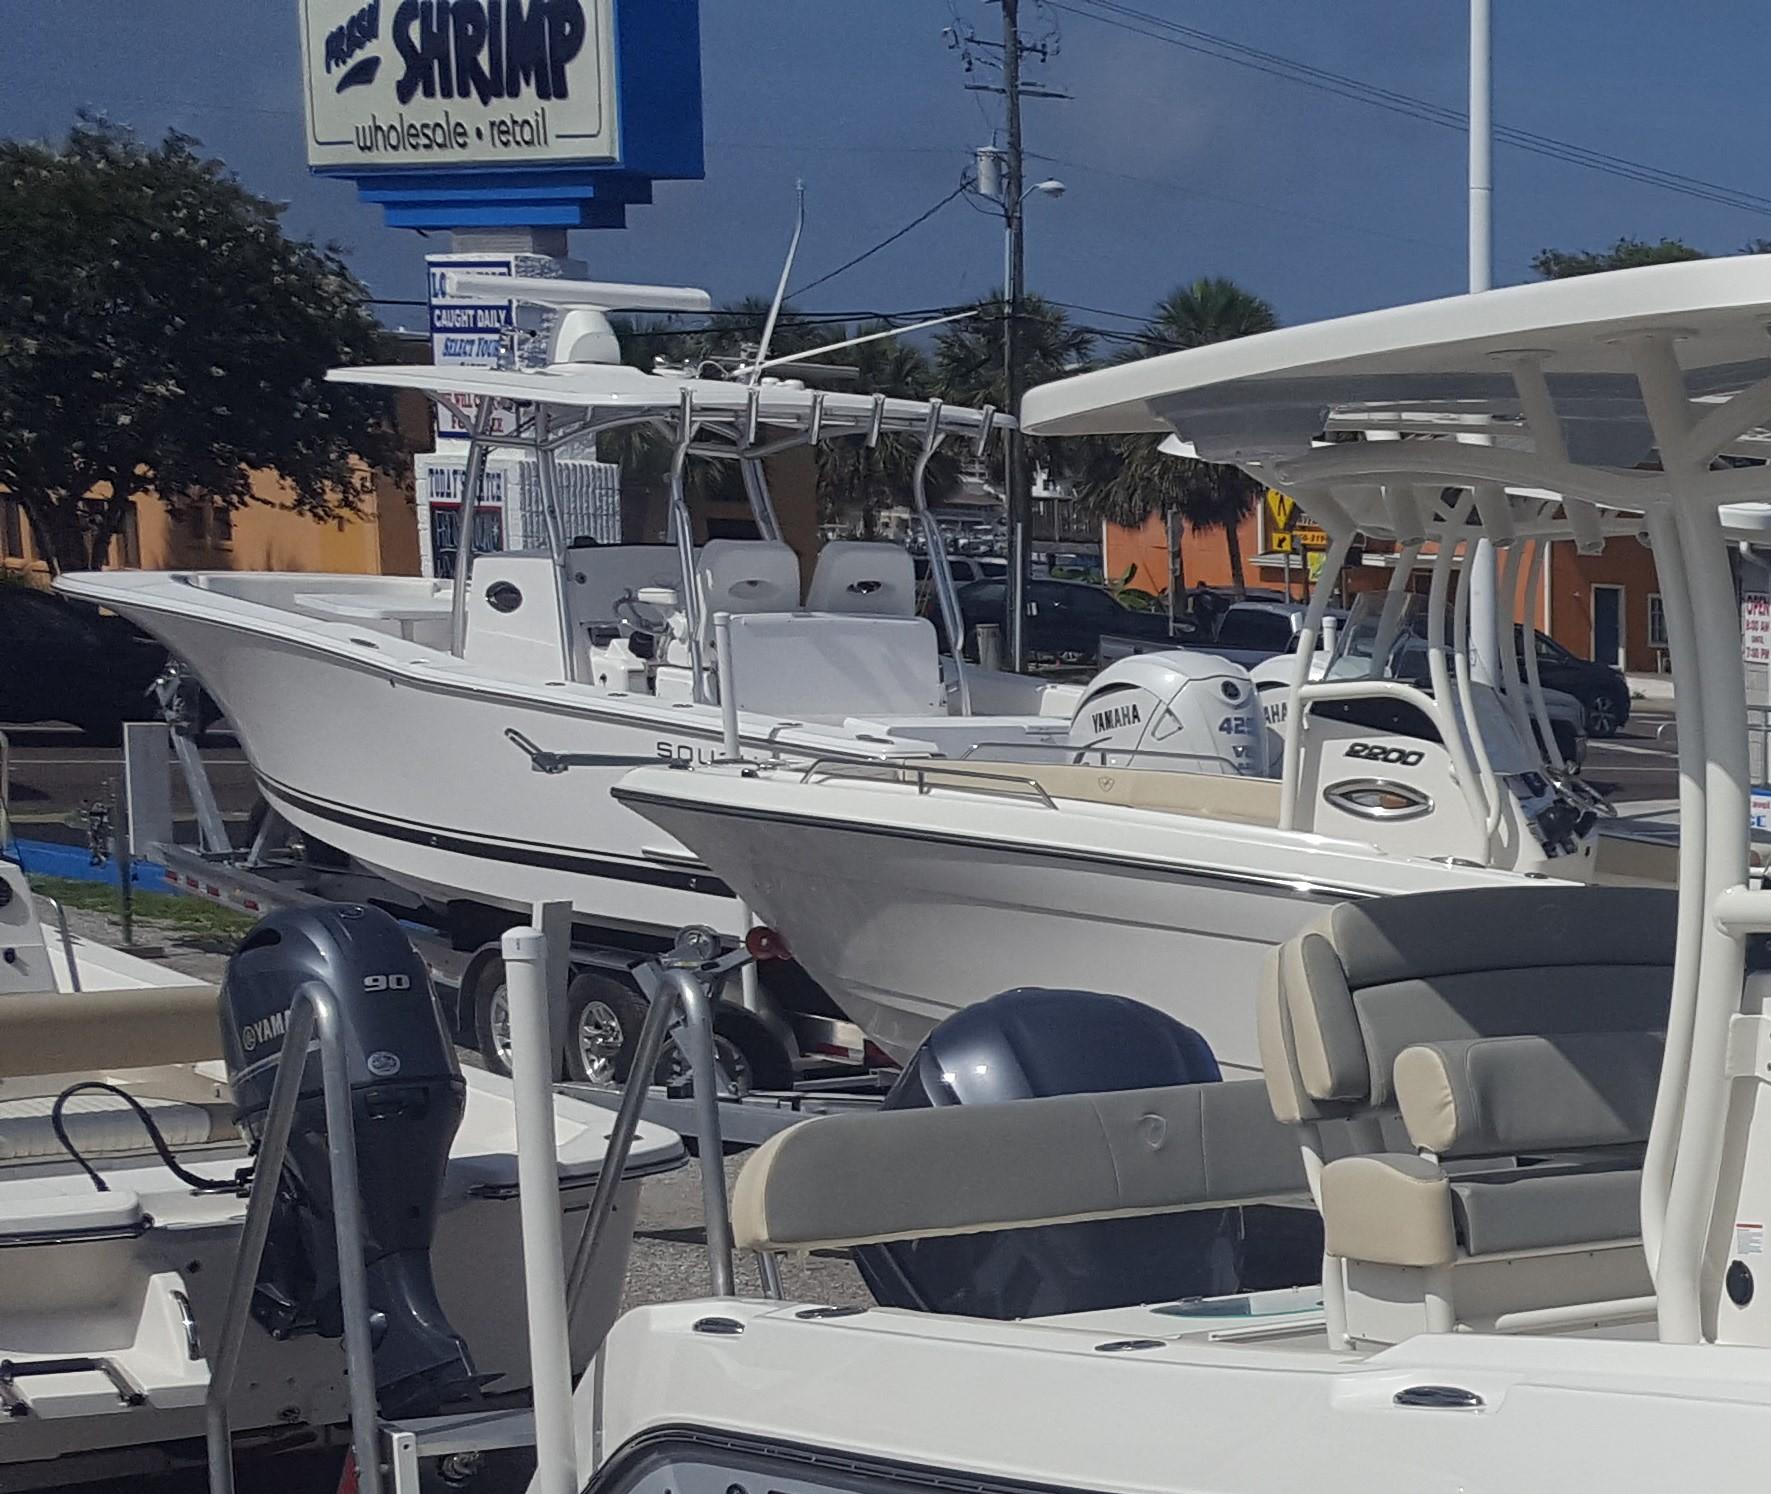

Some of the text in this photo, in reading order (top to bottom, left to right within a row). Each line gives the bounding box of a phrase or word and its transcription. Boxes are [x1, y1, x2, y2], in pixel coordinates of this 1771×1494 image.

[392, 0, 586, 106] SHRIMP
[354, 107, 549, 151] wholesale retail
[434, 308, 507, 328] CAUGHT DAILY
[1091, 703, 1142, 734] YAMAHA
[1263, 702, 1288, 725] AHA
[1343, 742, 1426, 766] 2200
[364, 974, 411, 992] 90
[254, 1010, 292, 1044] YAM
